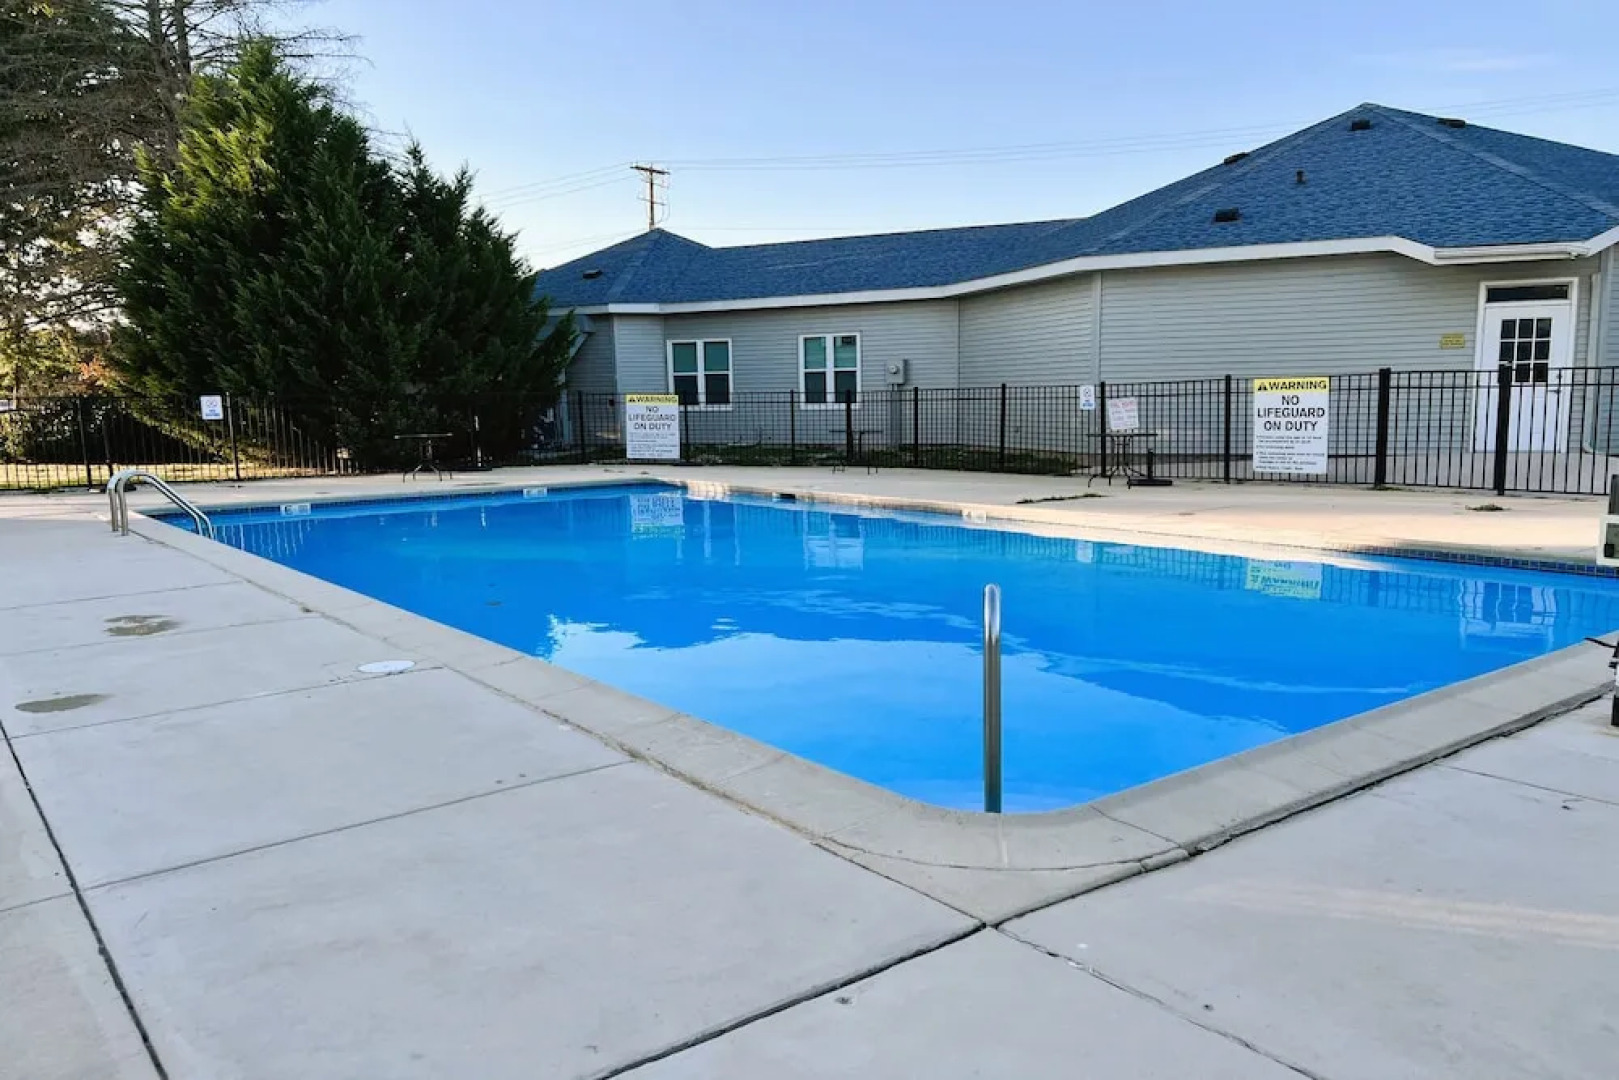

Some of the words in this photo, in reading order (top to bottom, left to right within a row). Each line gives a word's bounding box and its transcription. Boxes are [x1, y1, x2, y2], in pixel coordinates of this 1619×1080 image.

[1269, 381, 1327, 390] WARNING
[1281, 395, 1299, 405] NO
[1257, 407, 1325, 418] LIFEGUARD
[634, 422, 647, 430] ON
[649, 422, 672, 430] DUTY
[1264, 421, 1281, 431] ON
[1285, 421, 1318, 431] DUTY
